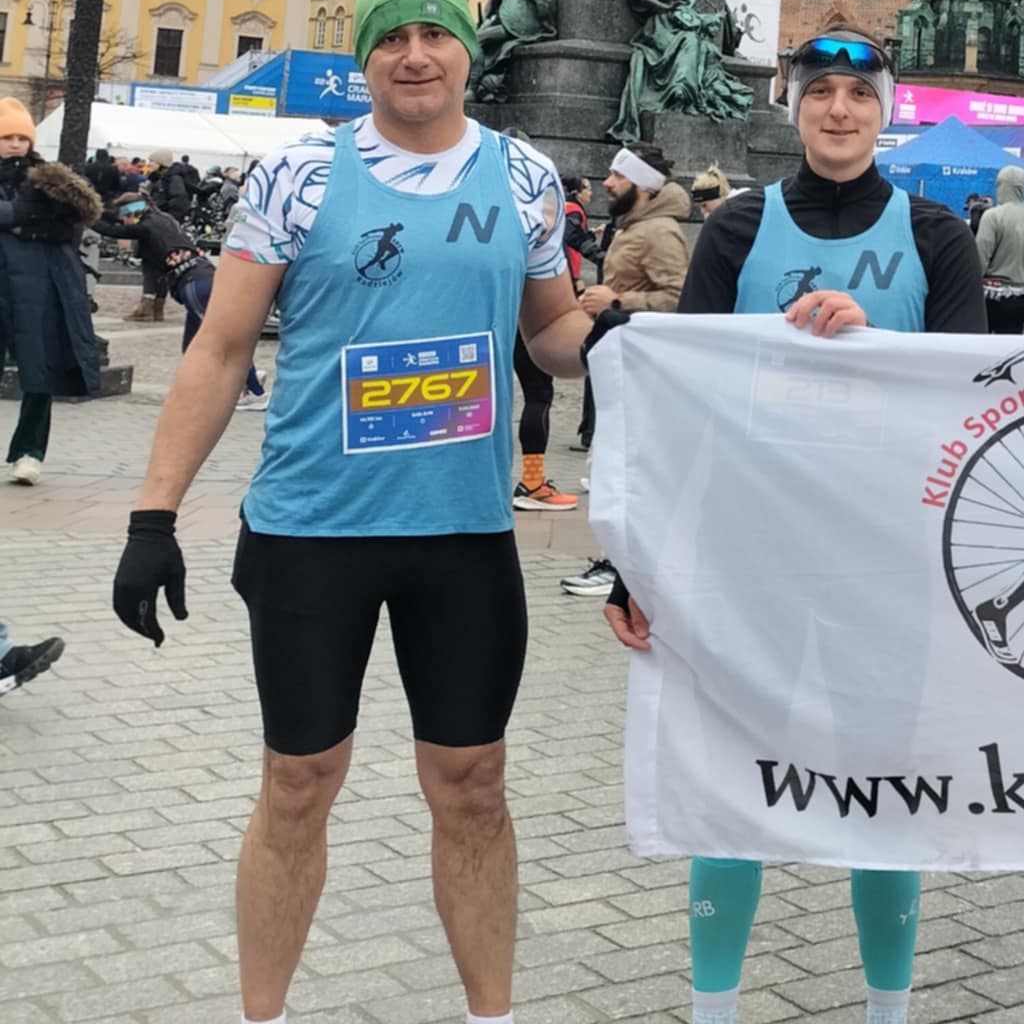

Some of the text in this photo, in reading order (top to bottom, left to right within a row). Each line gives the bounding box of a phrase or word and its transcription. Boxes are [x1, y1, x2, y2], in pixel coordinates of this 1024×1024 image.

[347, 92, 372, 103] MARA
[446, 202, 500, 244] N
[848, 249, 904, 291] N
[361, 369, 479, 409] 2767
[921, 439, 969, 509] Klub
